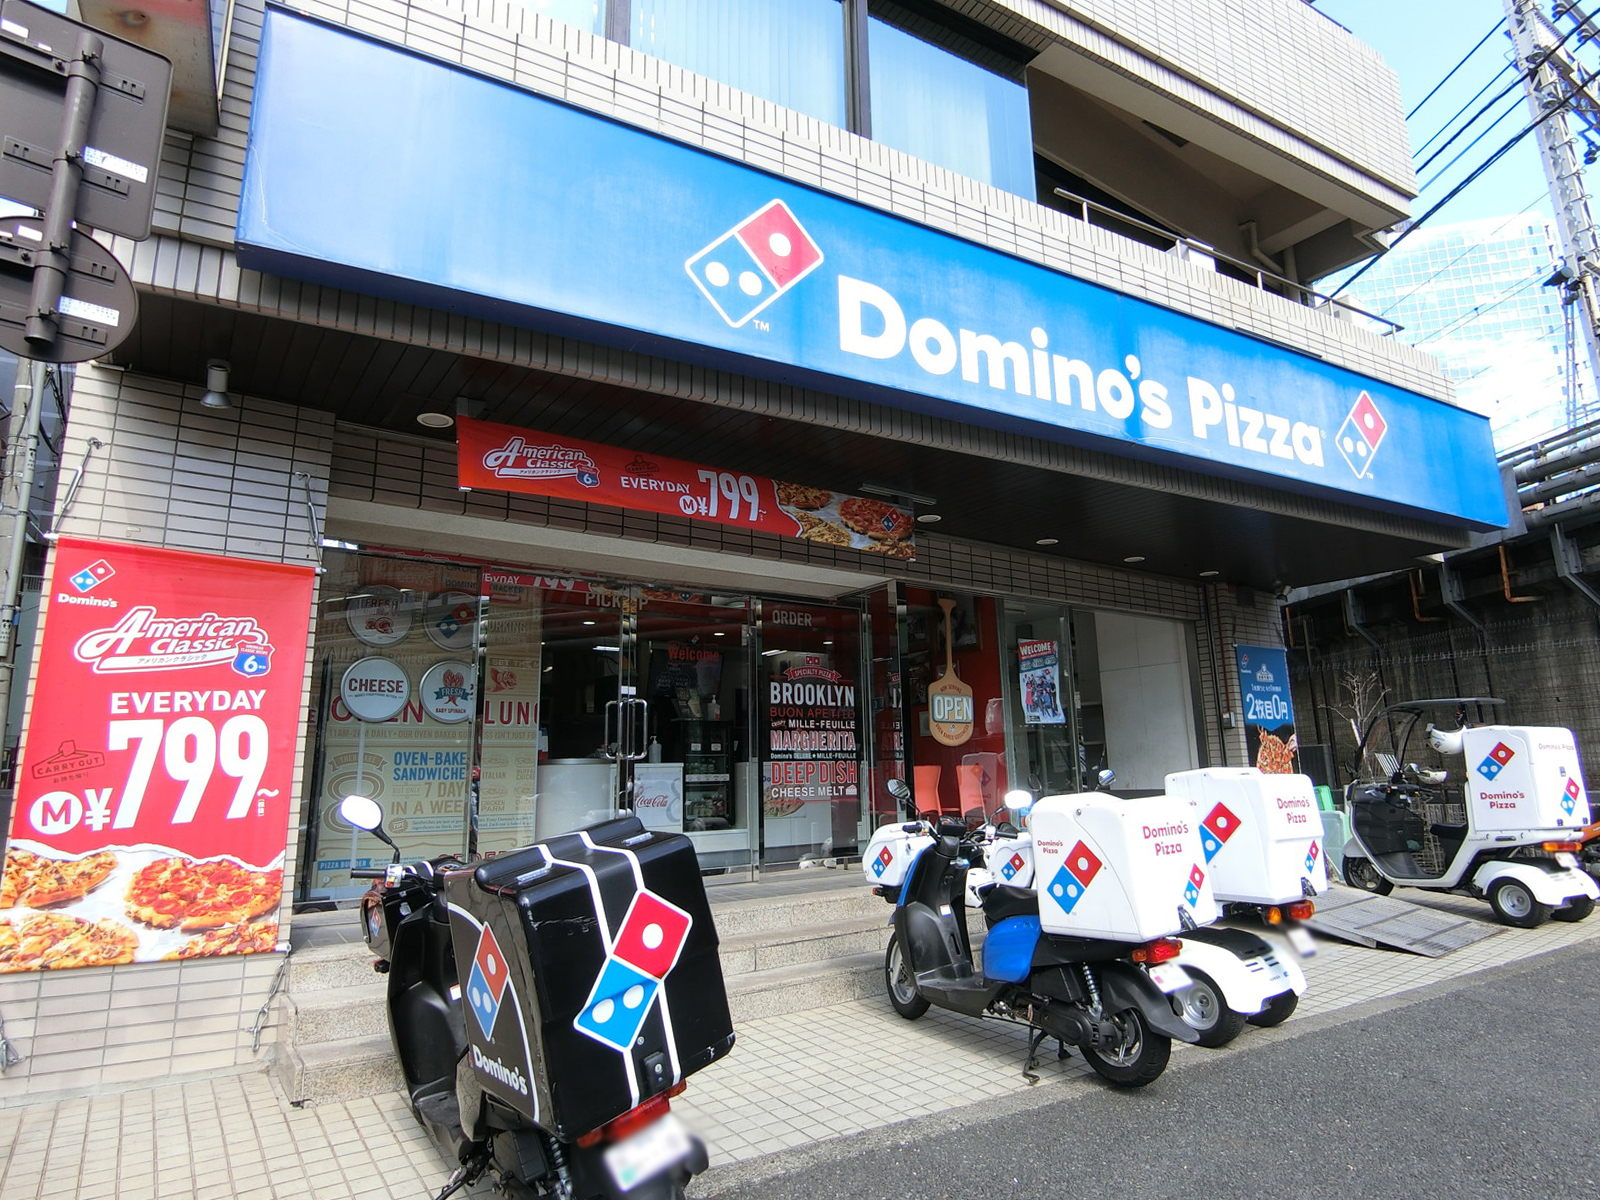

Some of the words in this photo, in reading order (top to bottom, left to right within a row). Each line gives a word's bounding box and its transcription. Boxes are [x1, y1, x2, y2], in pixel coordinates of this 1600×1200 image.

[838, 274, 1172, 428] Domino's
[1187, 376, 1324, 467] Pizza
[485, 438, 591, 468] American
[526, 458, 574, 469] Classic
[582, 473, 593, 484] 6
[620, 476, 690, 494] EVERYDAY
[58, 593, 117, 608] Domino's
[772, 609, 812, 627] ORDER
[80, 606, 265, 657] American
[151, 638, 234, 654] Classic
[1020, 642, 1051, 656] WELCOME
[668, 647, 720, 662] Welcome
[243, 655, 258, 672] 6
[794, 668, 818, 676] SPECIALTY
[349, 678, 404, 693] CHEESE
[441, 688, 463, 697] FRESH
[110, 689, 267, 715] EVERYDAY
[770, 682, 855, 707] BROOKLYN
[770, 707, 804, 718] BUON
[934, 695, 972, 720] OPEN
[1246, 693, 1289, 720] 2枚目0円
[788, 719, 855, 729] MILLE-FEUILLE
[770, 730, 856, 751] MARGHERITA
[37, 761, 75, 775] CARRY
[78, 757, 100, 767] OUT
[393, 752, 467, 766] OVEN-BAKE
[393, 767, 466, 781] SANDWICHE
[771, 761, 816, 785] DEEP
[819, 761, 857, 784] DISH
[425, 782, 432, 798] 7
[438, 781, 464, 798] DAY
[771, 787, 815, 798] CHEESE
[818, 786, 845, 796] MELT
[1480, 790, 1525, 800] Domino's
[391, 801, 407, 815] IN
[413, 800, 424, 814] A
[430, 800, 464, 813] WEE
[1277, 797, 1310, 809] Domino's
[1489, 801, 1516, 809] Pizza
[1286, 812, 1307, 825] Pizza
[1142, 821, 1189, 840] Domino's
[1037, 840, 1063, 848] Domino's
[1155, 842, 1182, 856] Pizza
[320, 861, 339, 869] PIZZA
[340, 860, 367, 868] BUDER
[472, 1044, 528, 1095] Domino's
